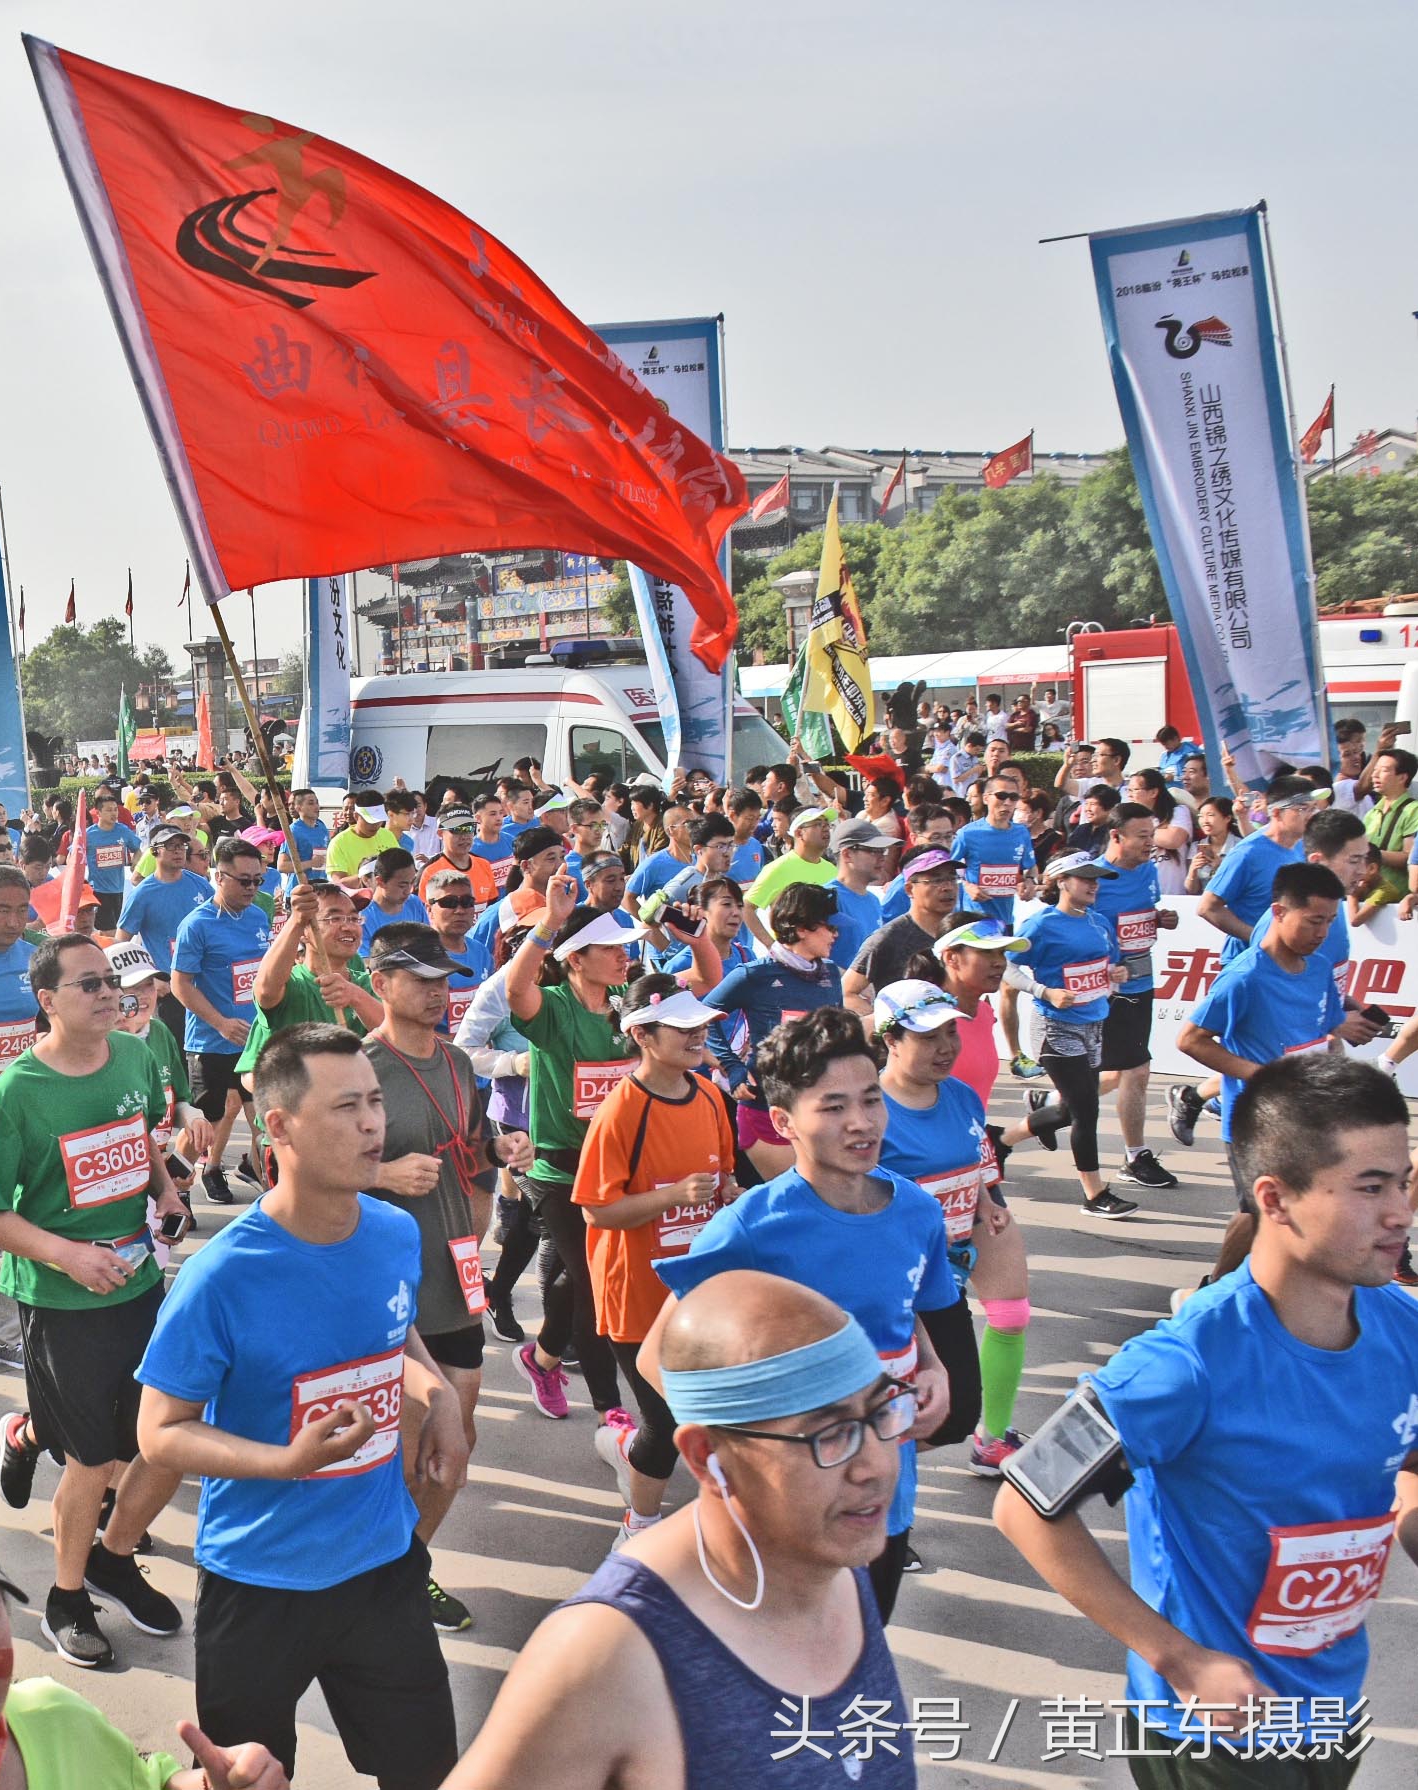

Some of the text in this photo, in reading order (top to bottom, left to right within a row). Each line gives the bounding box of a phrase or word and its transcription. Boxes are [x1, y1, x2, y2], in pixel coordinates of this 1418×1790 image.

[1180, 371, 1197, 418] SHANXI
[1186, 419, 1200, 440] JIN
[1189, 440, 1211, 522] EMBROIDERY
[1199, 383, 1252, 650] 山西锦之绣文化传媒有限公司
[1200, 526, 1218, 581] CULTURE
[981, 875, 1017, 886] C2406
[1120, 923, 1156, 938] C2489
[74, 1138, 147, 1180] C3608
